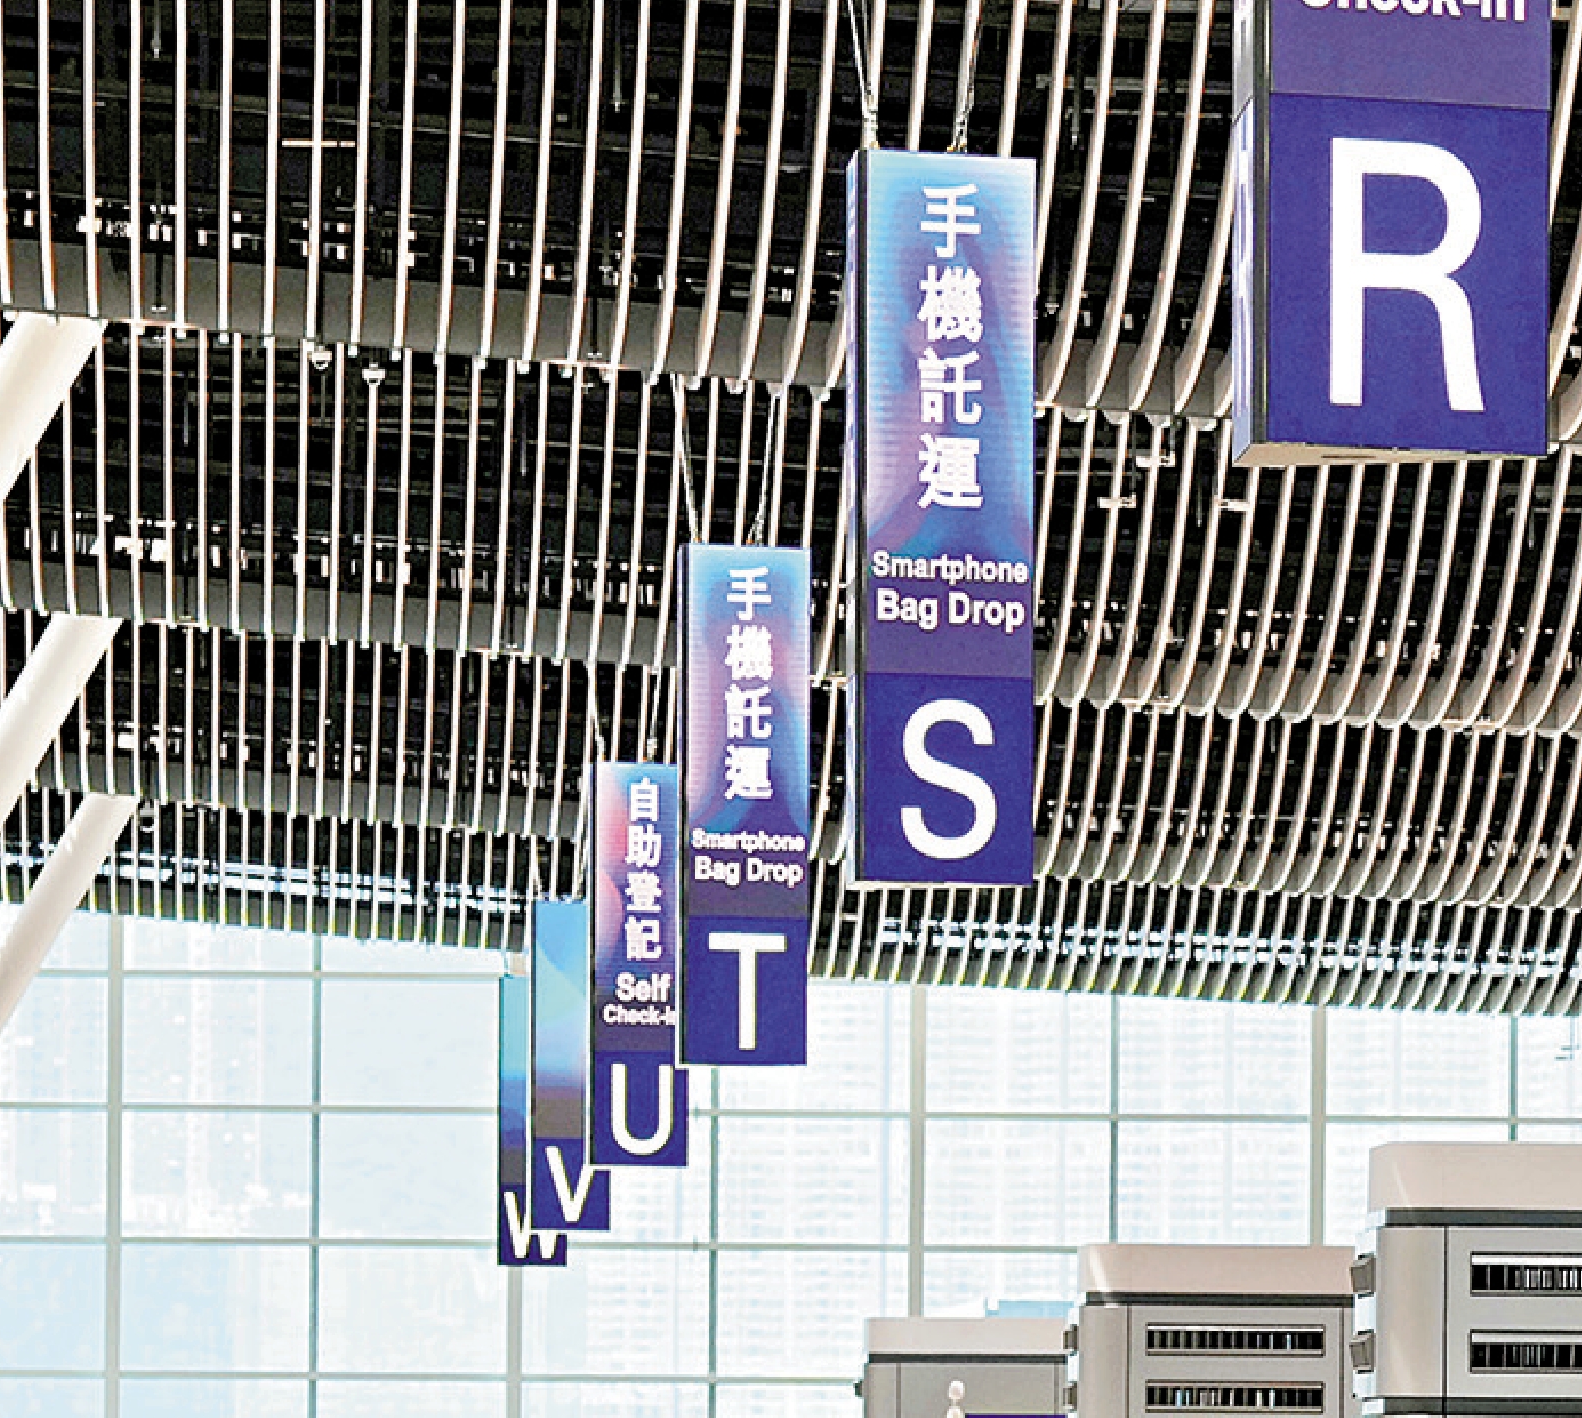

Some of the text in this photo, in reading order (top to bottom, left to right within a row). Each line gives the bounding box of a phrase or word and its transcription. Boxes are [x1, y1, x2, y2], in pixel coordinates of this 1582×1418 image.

[1328, 136, 1484, 412] R
[916, 183, 983, 509] 手機託運
[872, 549, 1030, 586] Smartphone
[876, 587, 1026, 634] Bag Drop
[724, 565, 774, 801] 手機託運
[900, 698, 997, 860] S
[625, 776, 663, 962] 自助登記
[692, 827, 806, 854] Smartphone
[694, 855, 804, 889] Bag Drop
[615, 971, 671, 1002] Self
[708, 931, 786, 1052] T
[610, 1063, 674, 1156] U
[544, 1145, 595, 1222] V
